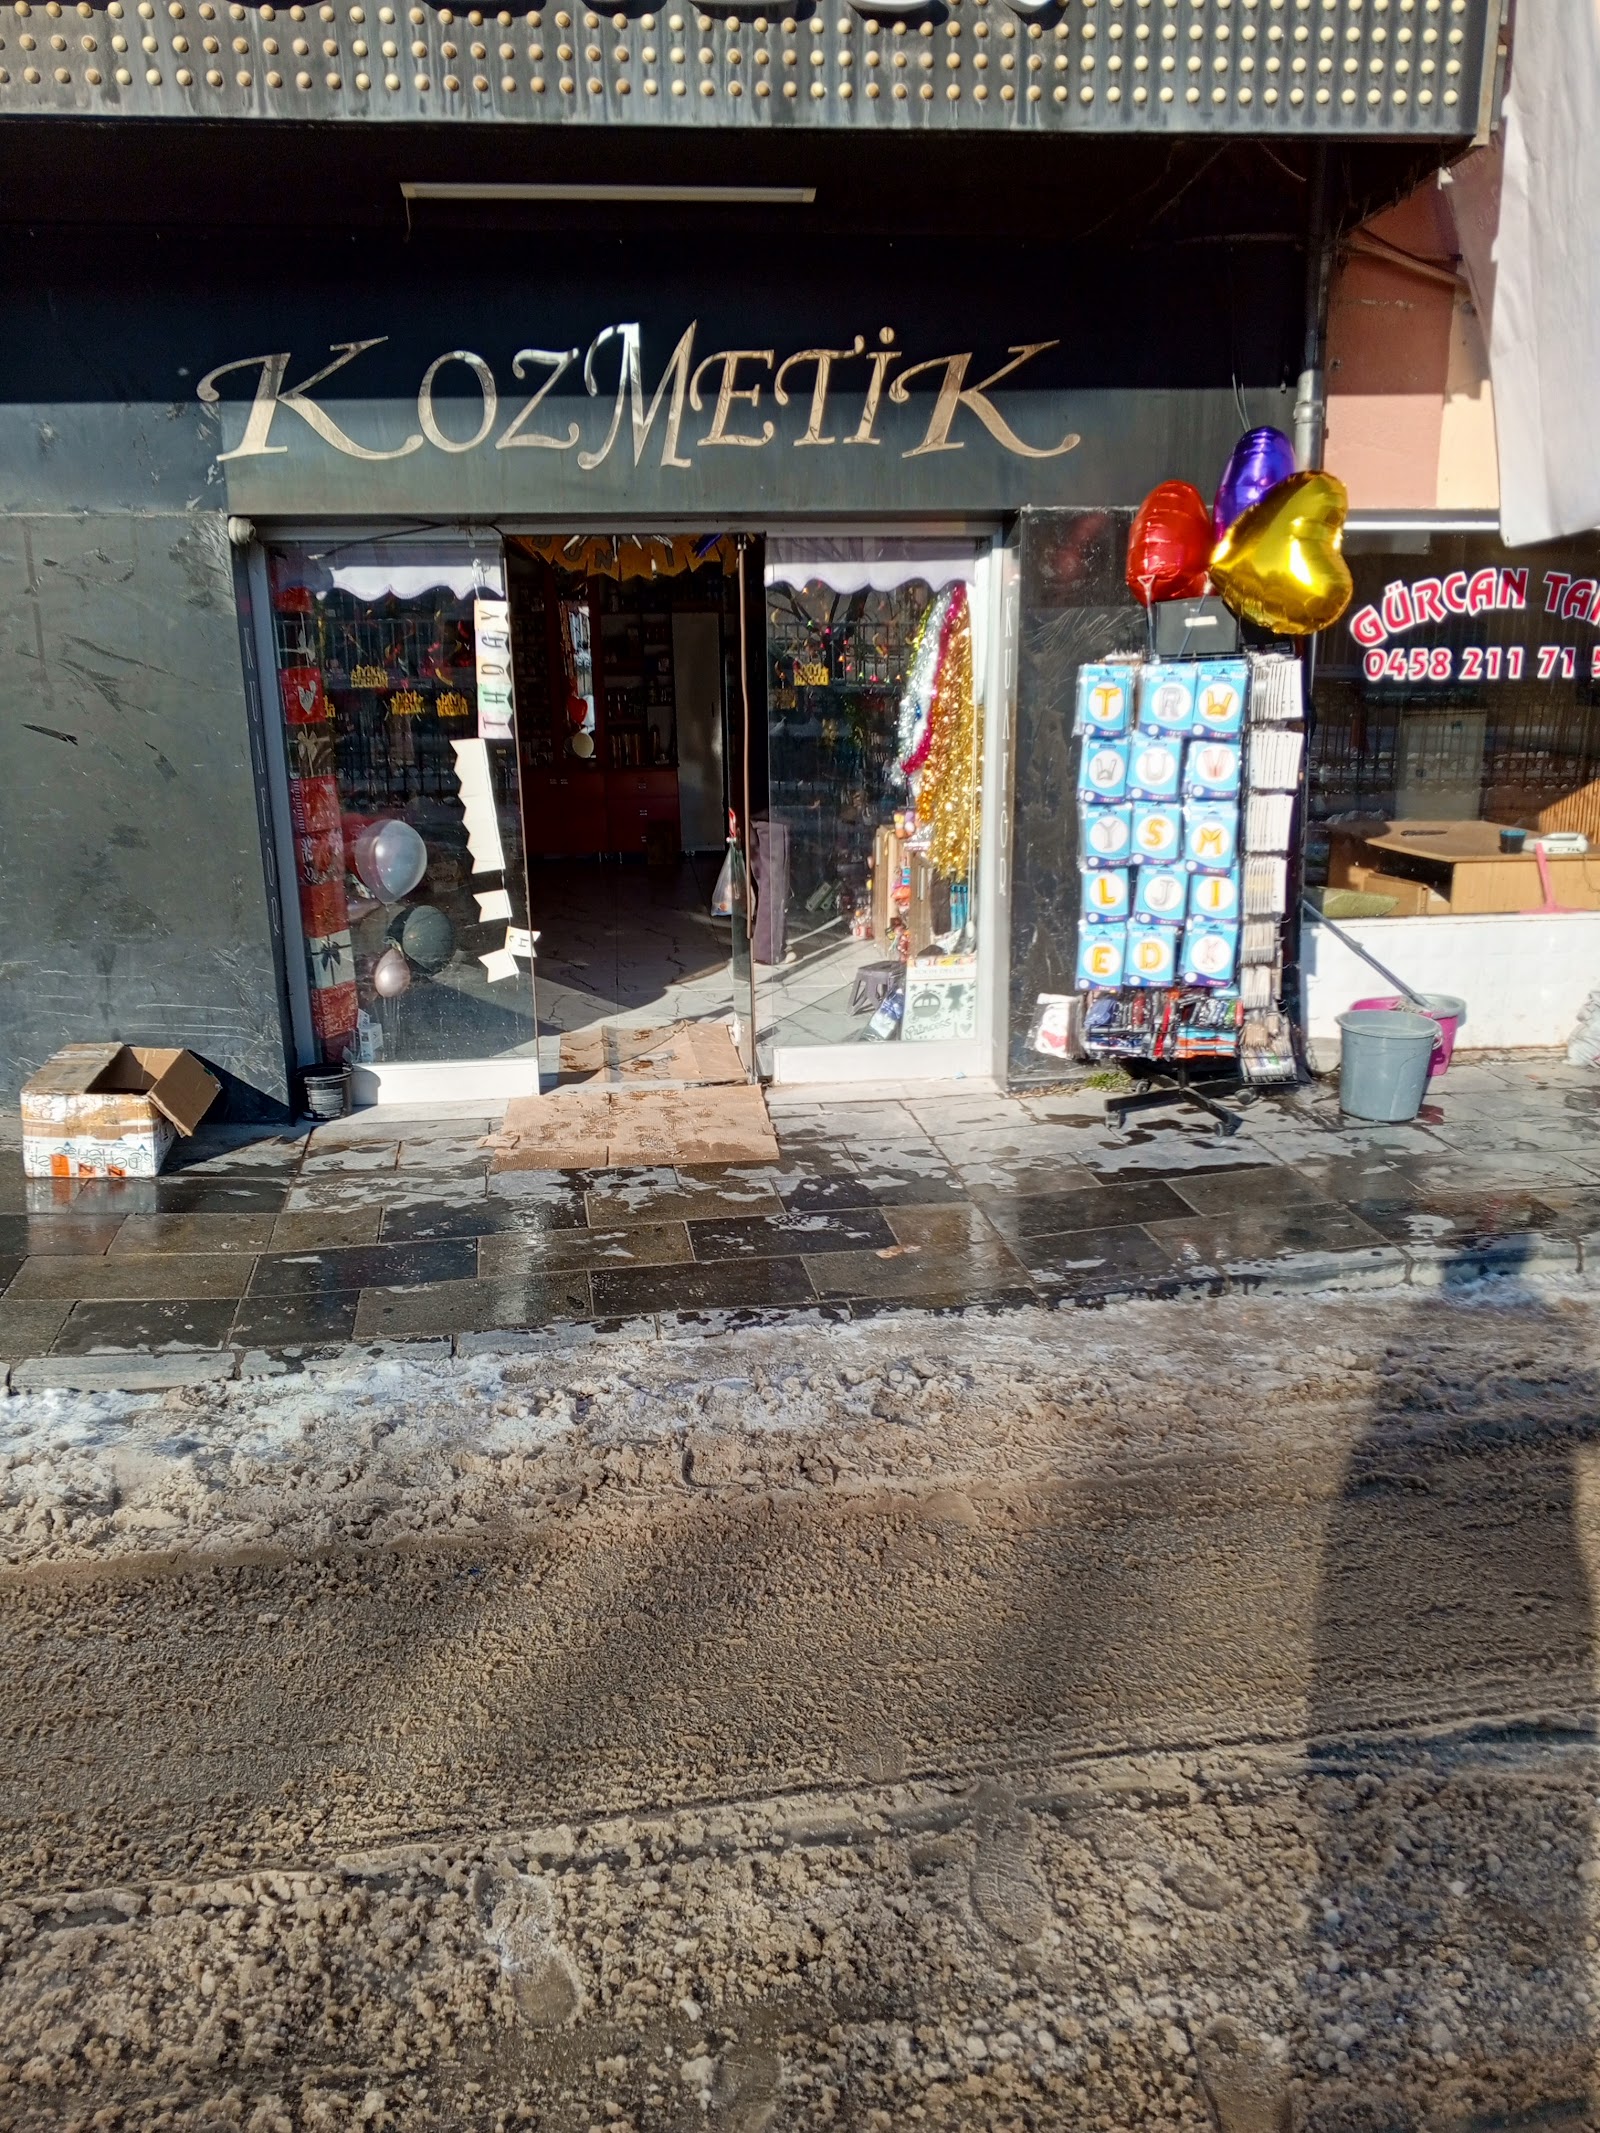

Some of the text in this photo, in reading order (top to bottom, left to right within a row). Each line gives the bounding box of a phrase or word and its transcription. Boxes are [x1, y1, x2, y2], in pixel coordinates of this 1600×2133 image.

[196, 319, 1082, 470] KOZMETİK
[1349, 567, 1530, 648] GÜRCAN
[1363, 647, 1453, 681] 0458
[1459, 646, 1524, 680] 211
[1537, 646, 1577, 680] 71
[1095, 688, 1121, 716] T
[1145, 818, 1167, 846] S
[1196, 826, 1228, 855] M
[1099, 878, 1116, 906] L
[1091, 945, 1111, 974] E
[1139, 941, 1164, 970] D
